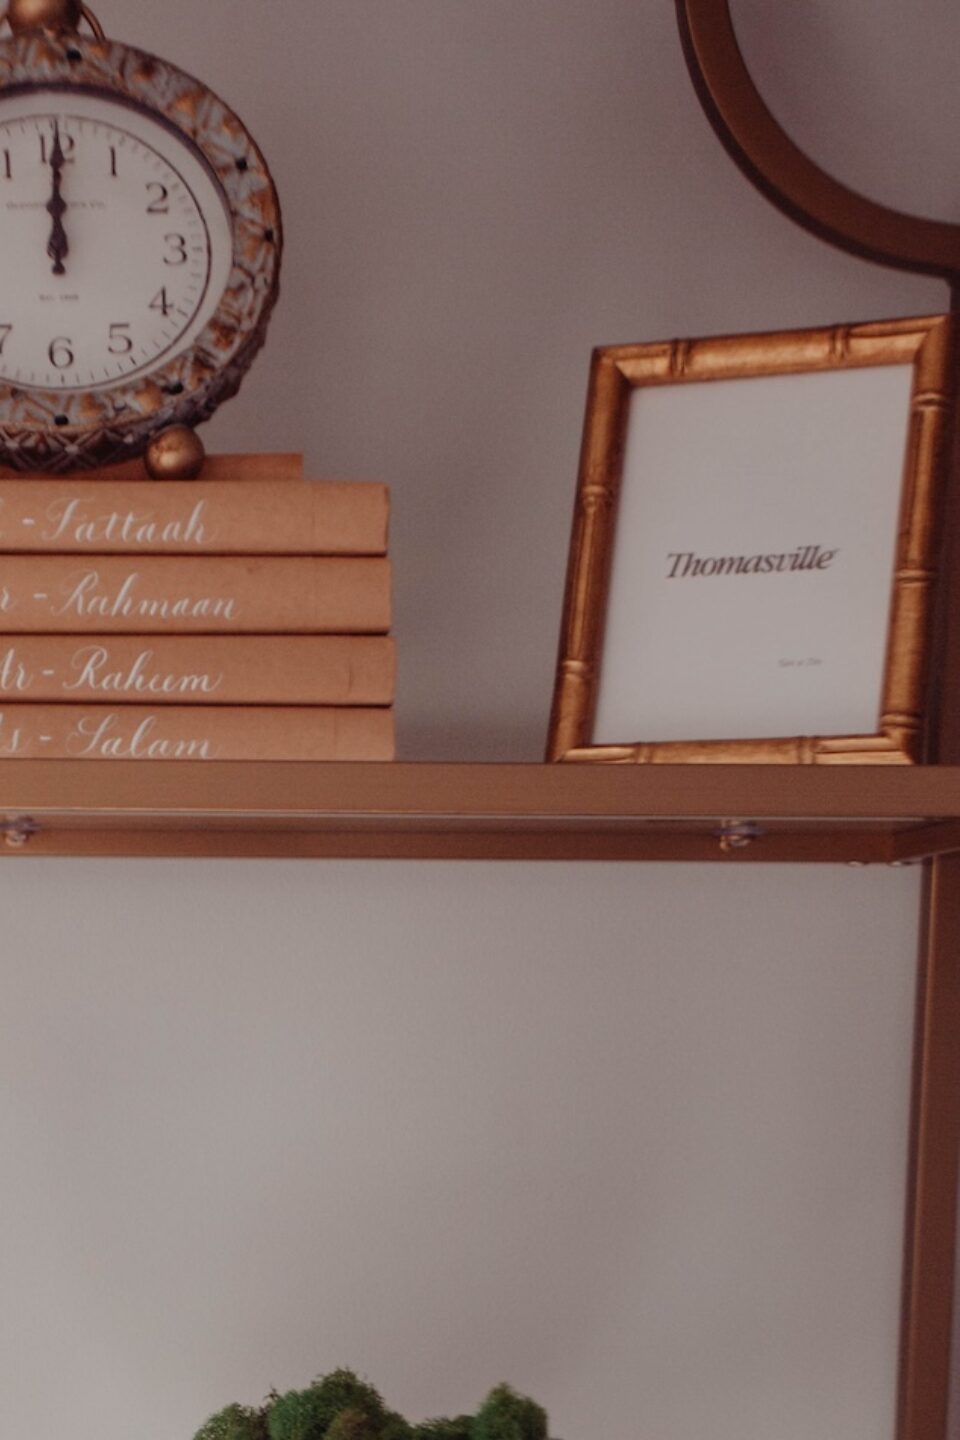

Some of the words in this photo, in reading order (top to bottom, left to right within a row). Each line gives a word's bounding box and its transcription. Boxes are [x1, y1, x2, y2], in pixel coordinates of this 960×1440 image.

[108, 146, 118, 177] 1
[145, 182, 170, 214] 2
[162, 233, 188, 266] 3
[148, 286, 173, 317] 4
[48, 337, 74, 369] 6
[107, 323, 133, 355] 5
[665, 545, 839, 579] Thomasville
